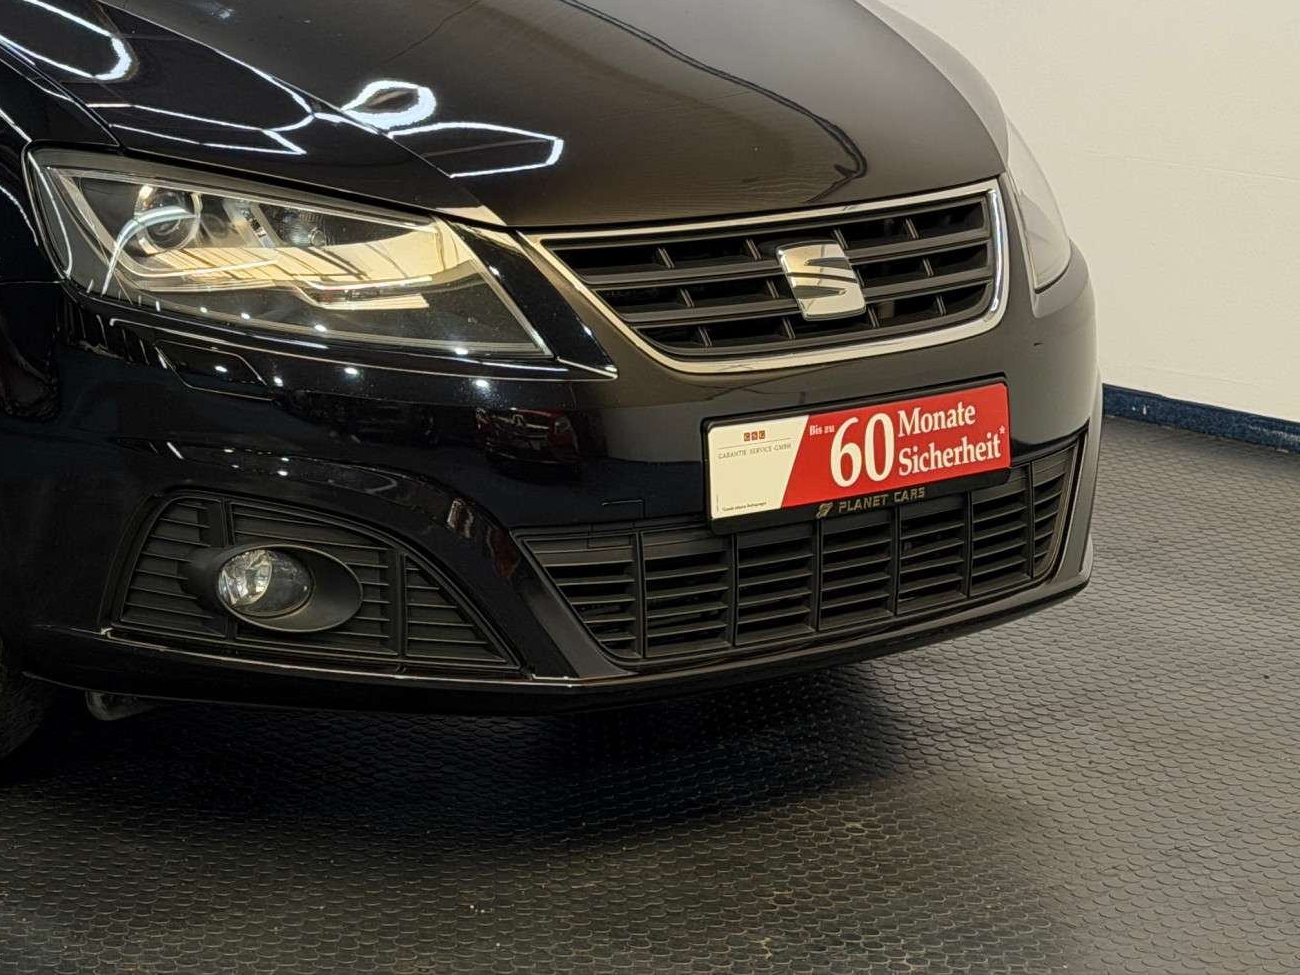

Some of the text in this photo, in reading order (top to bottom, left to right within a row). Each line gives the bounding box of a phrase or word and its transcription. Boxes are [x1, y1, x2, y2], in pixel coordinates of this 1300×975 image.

[897, 401, 976, 438] Monate
[809, 412, 895, 488] Bis zu 60
[839, 487, 926, 514] PLANET CARS
